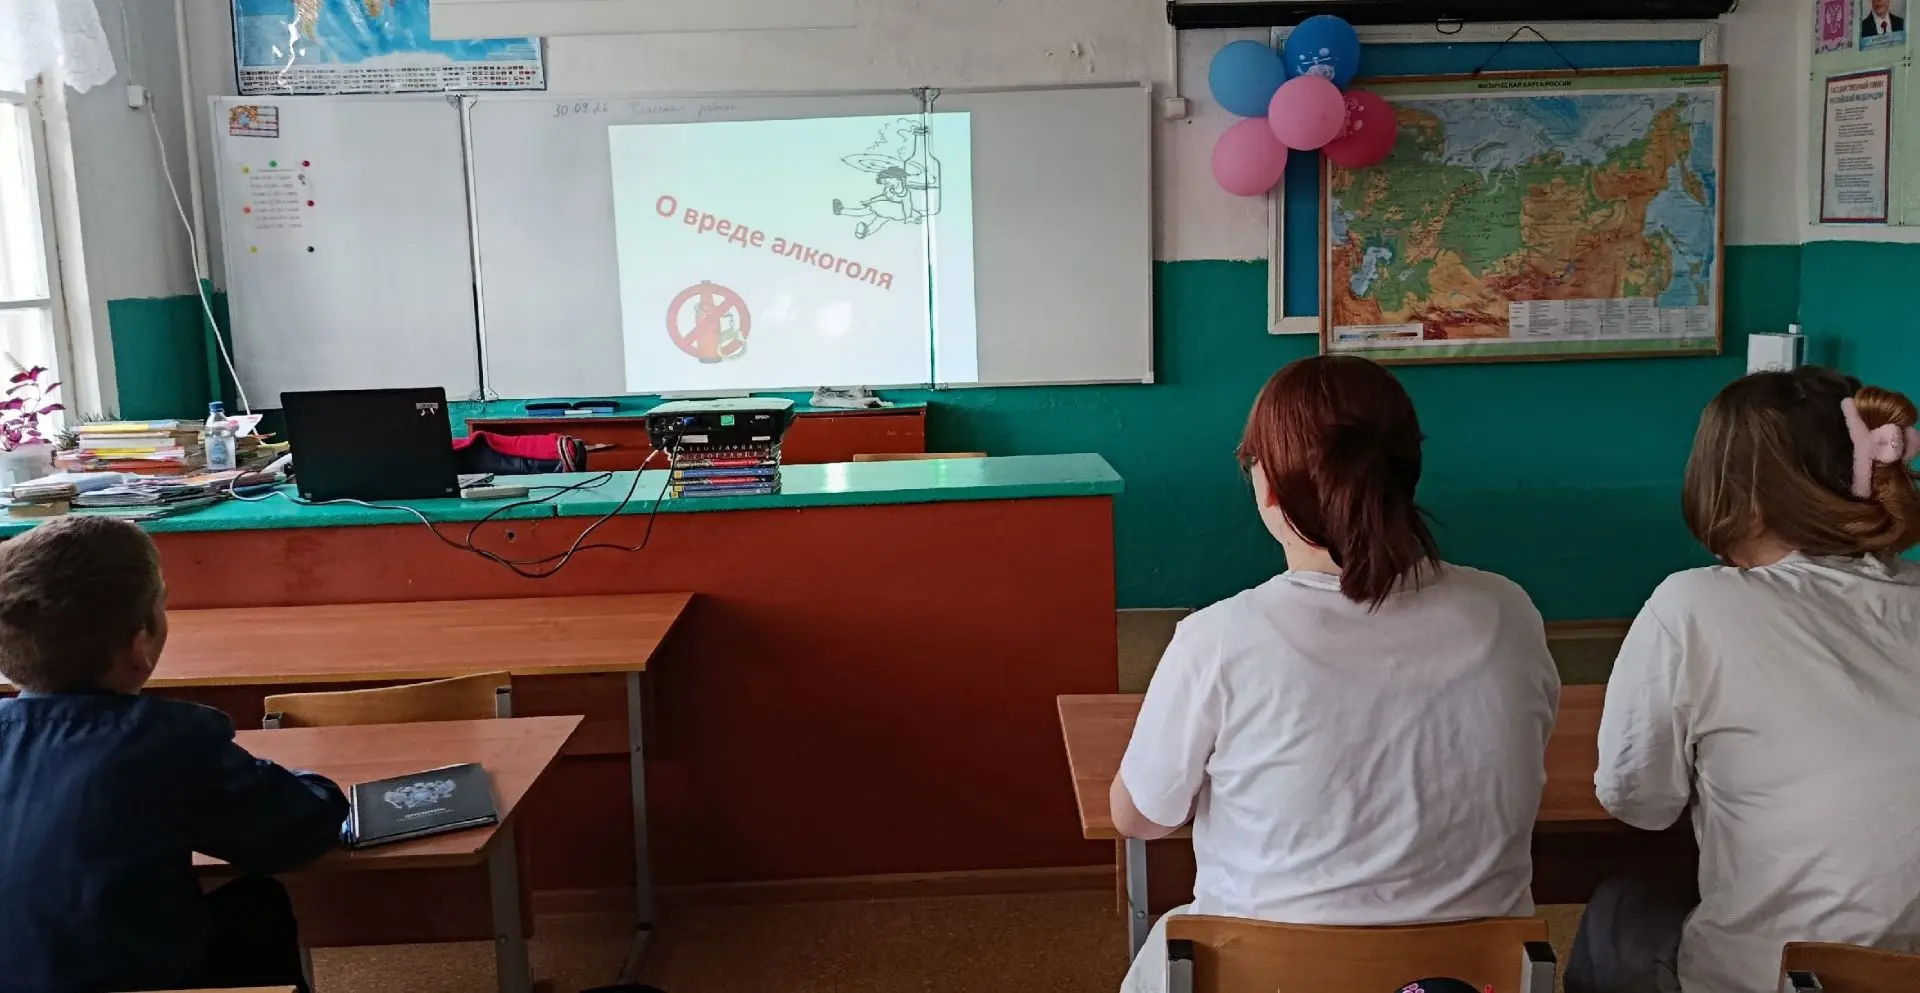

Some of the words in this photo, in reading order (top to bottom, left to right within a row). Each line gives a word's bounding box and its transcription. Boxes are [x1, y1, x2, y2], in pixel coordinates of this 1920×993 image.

[656, 195, 677, 217] О
[683, 206, 765, 249] вреде
[771, 236, 893, 290] алкоголя
